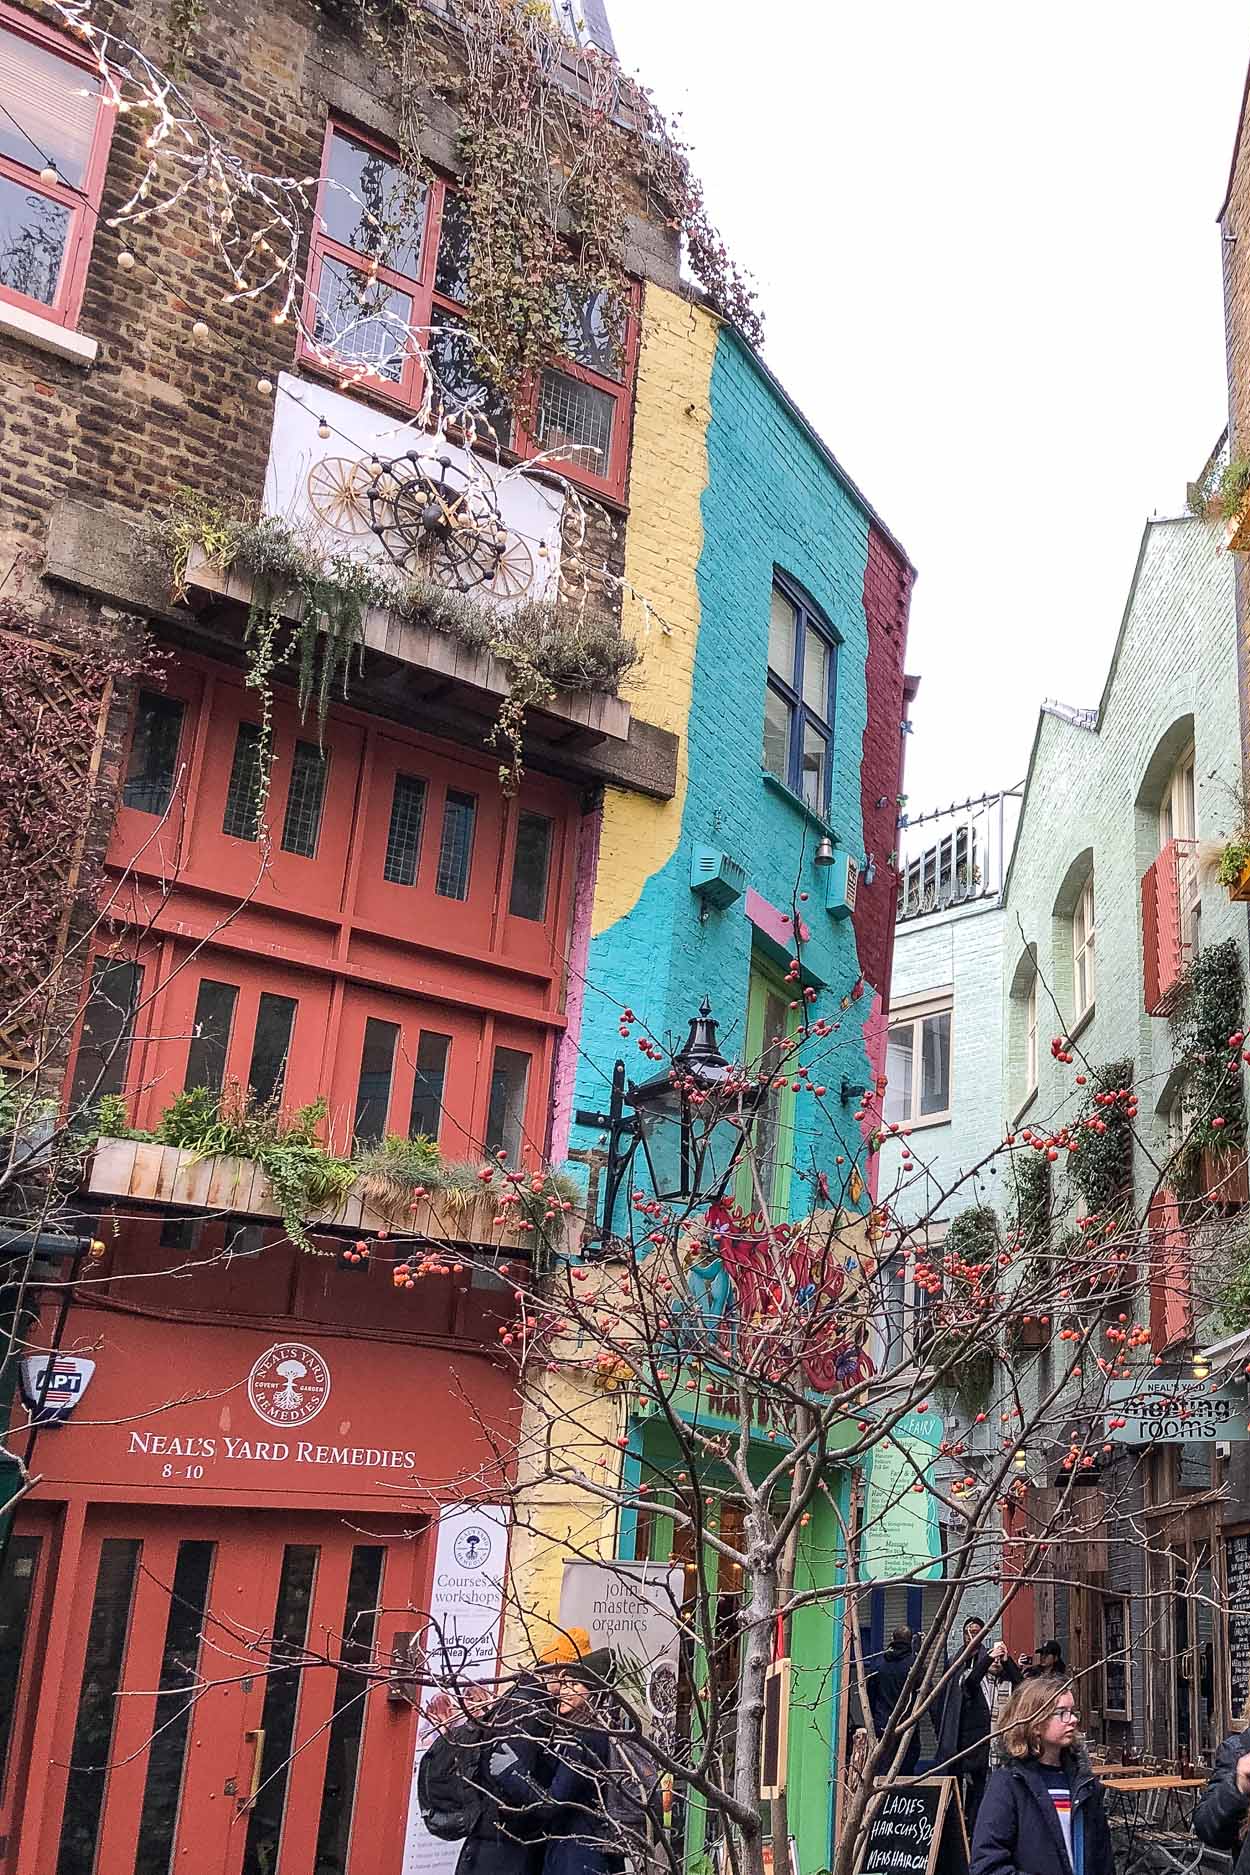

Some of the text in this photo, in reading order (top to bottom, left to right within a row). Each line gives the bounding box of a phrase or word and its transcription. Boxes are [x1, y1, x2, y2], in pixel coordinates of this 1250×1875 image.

[256, 1348, 324, 1383] NEAL'S YARD
[37, 1374, 80, 1390] APT
[255, 1392, 320, 1420] REMEDIES
[908, 1420, 936, 1436] FAIRY
[1140, 1420, 1217, 1438] rooms
[128, 1432, 417, 1468] NEAL'S YARD REMEDIES
[437, 1574, 487, 1587] Courses
[606, 1579, 638, 1600] john
[435, 1590, 500, 1605] workshops
[593, 1599, 649, 1613] masters
[592, 1618, 648, 1638] organics
[475, 1648, 493, 1656] Yard
[883, 1794, 925, 1815] LADIES
